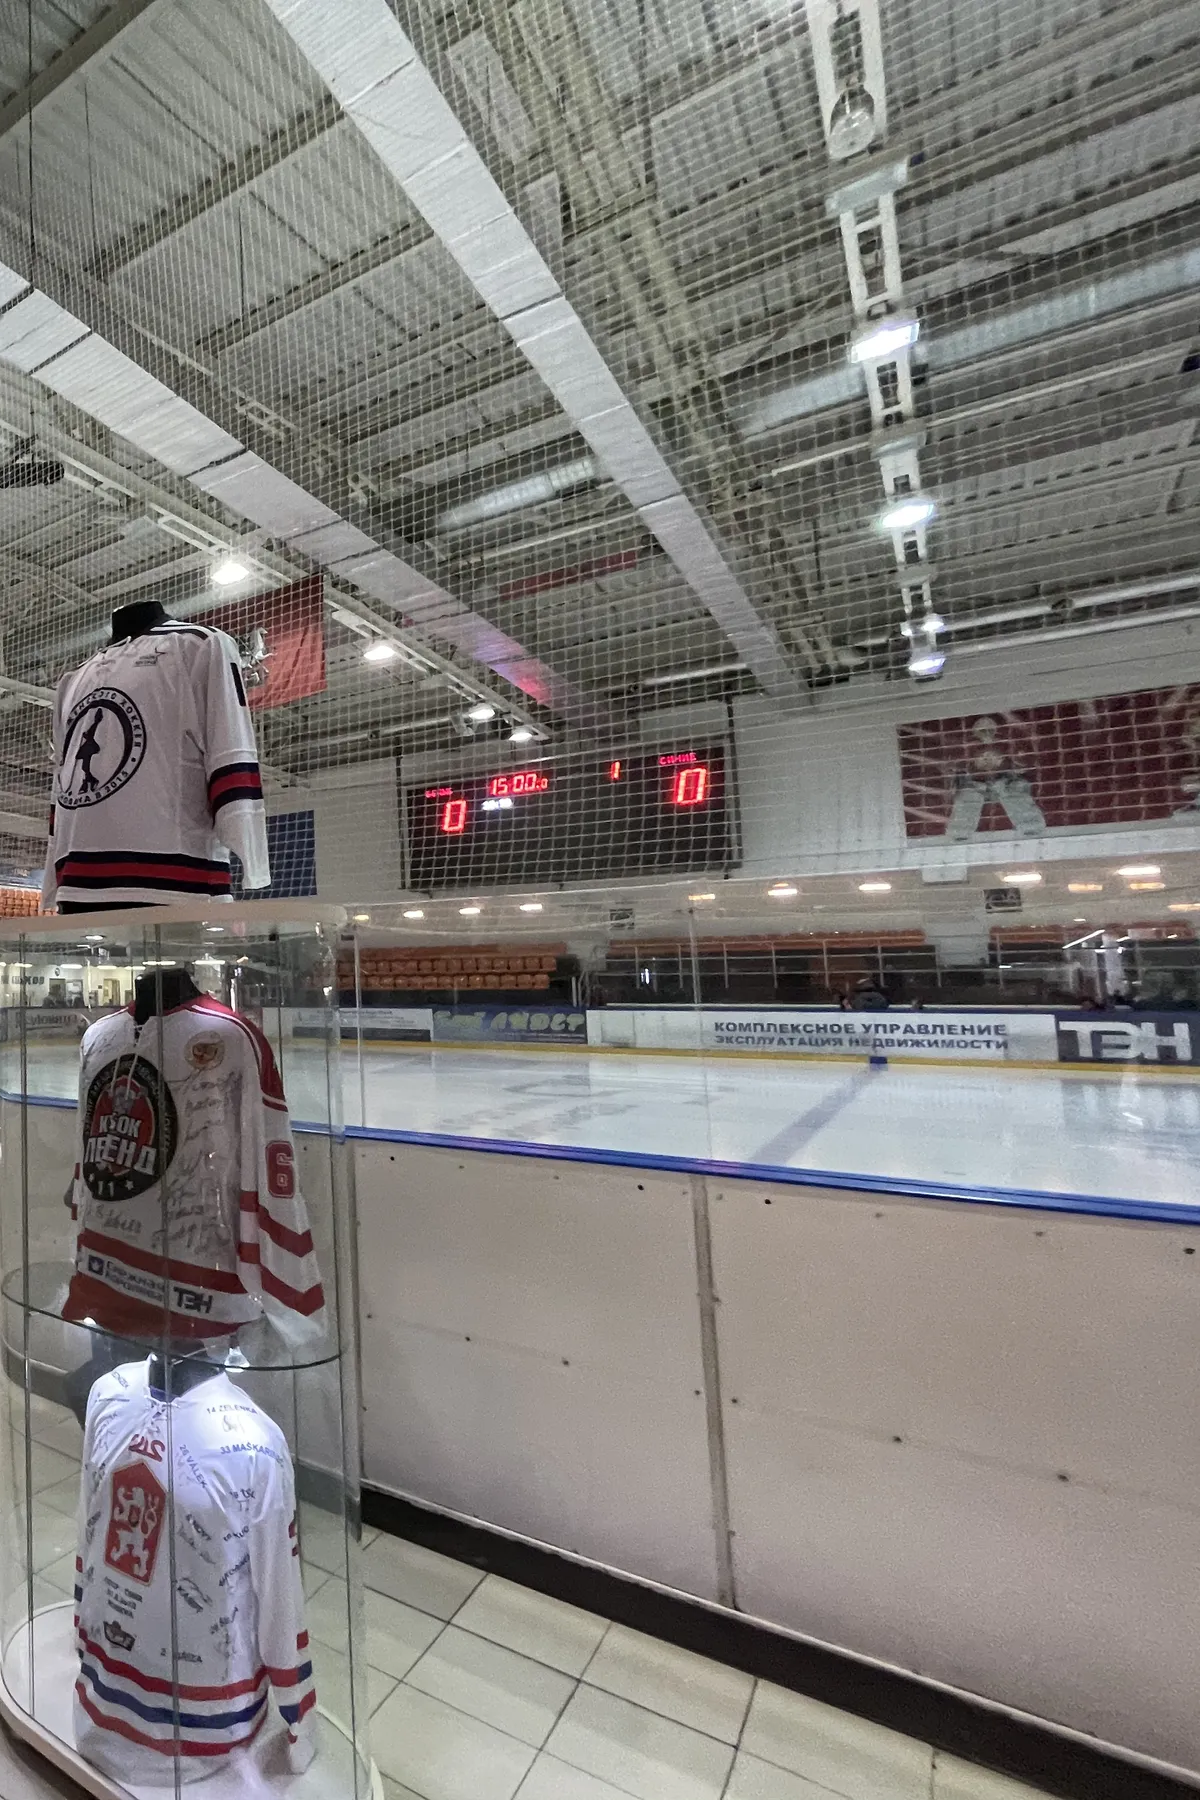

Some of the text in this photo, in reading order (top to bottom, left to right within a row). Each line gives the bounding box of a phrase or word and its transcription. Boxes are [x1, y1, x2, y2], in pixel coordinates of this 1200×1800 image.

[660, 752, 697, 765] СИНИЕ
[675, 767, 707, 805] 0
[442, 800, 467, 832] 0
[714, 1021, 1008, 1036] КОМПЛЕКСНОЕ УПРАВЛЕНИЕ
[715, 1034, 1009, 1050] ЭКСПЛУАТАЦИЯ НЕДВИЖИМОСТИ
[1058, 1020, 1192, 1061] ТЭН
[99, 1113, 142, 1138] КОК
[220, 1446, 231, 1455] 33
